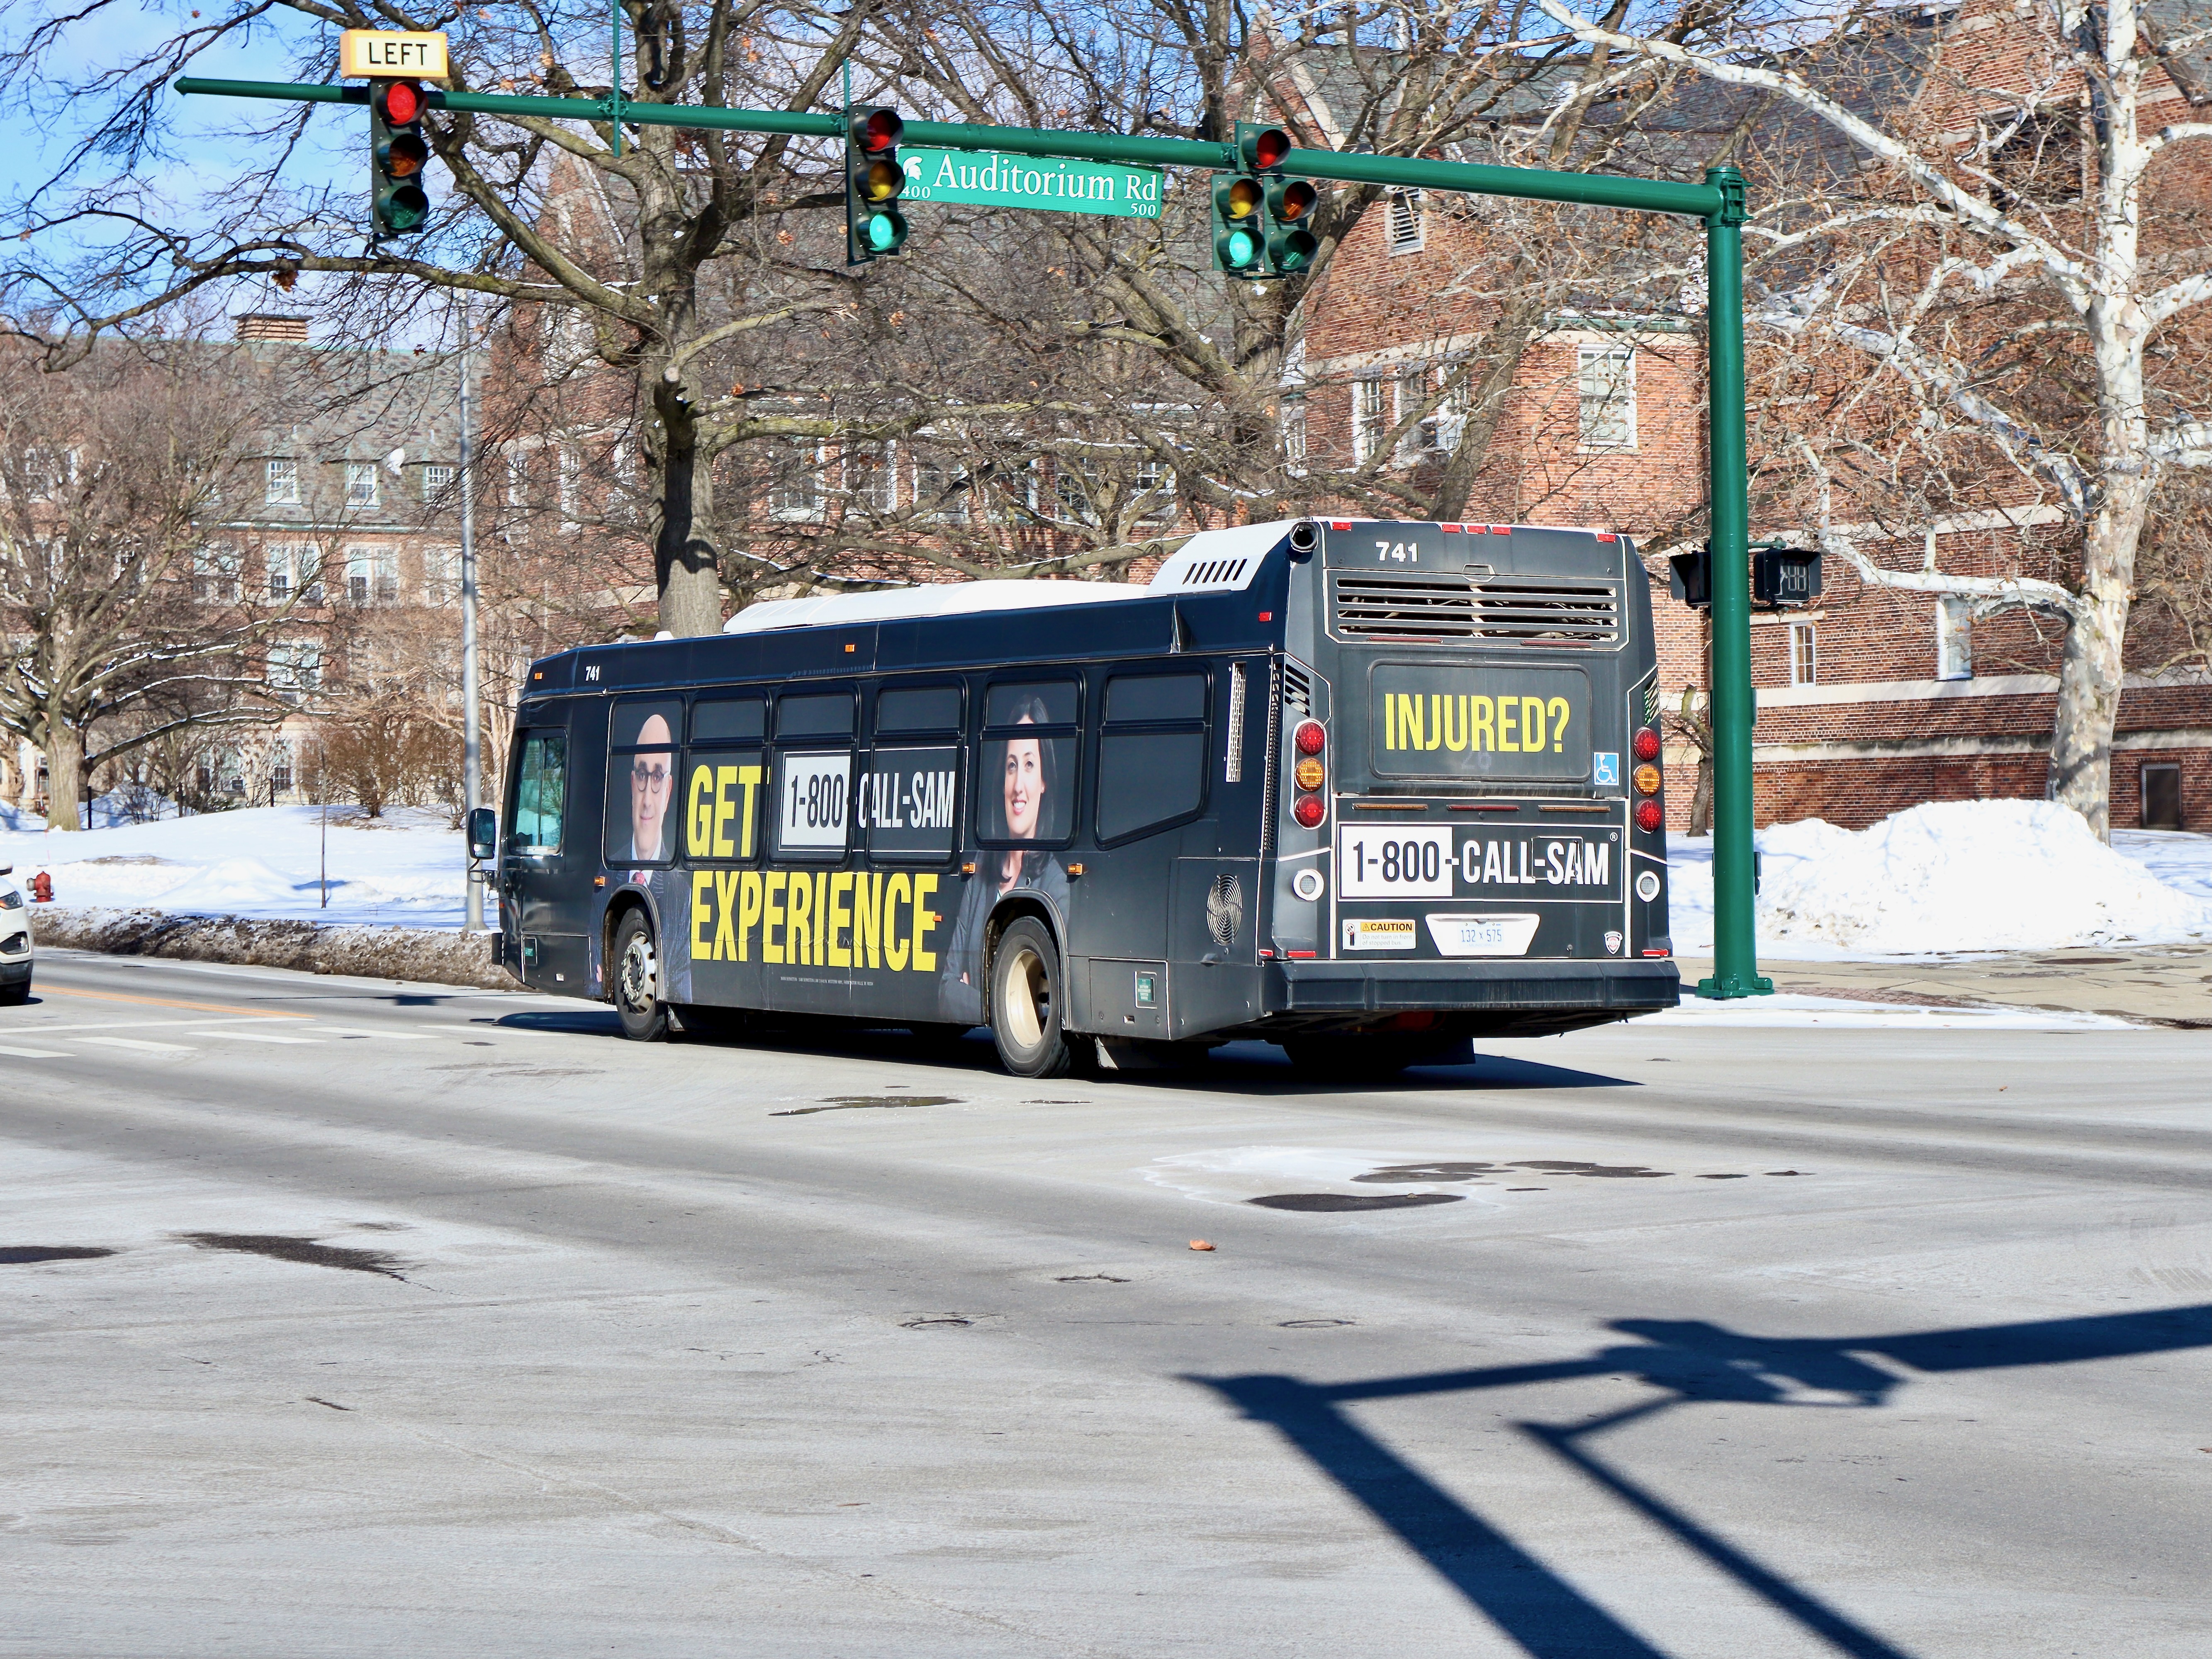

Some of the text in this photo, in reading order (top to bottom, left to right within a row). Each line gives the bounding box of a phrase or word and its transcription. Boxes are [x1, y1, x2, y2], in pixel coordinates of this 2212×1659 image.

[369, 42, 427, 66] LEFT
[932, 153, 1157, 201] Auditorium Rd
[901, 185, 931, 199] 400
[1130, 203, 1156, 216] 500
[1375, 541, 1418, 562] 741
[585, 665, 600, 681] 741
[1385, 693, 1570, 753] INJURED?
[687, 765, 770, 857] GET
[691, 871, 938, 972] EXPERIENCE
[1461, 929, 1476, 942] 132
[1486, 929, 1501, 942] 575
